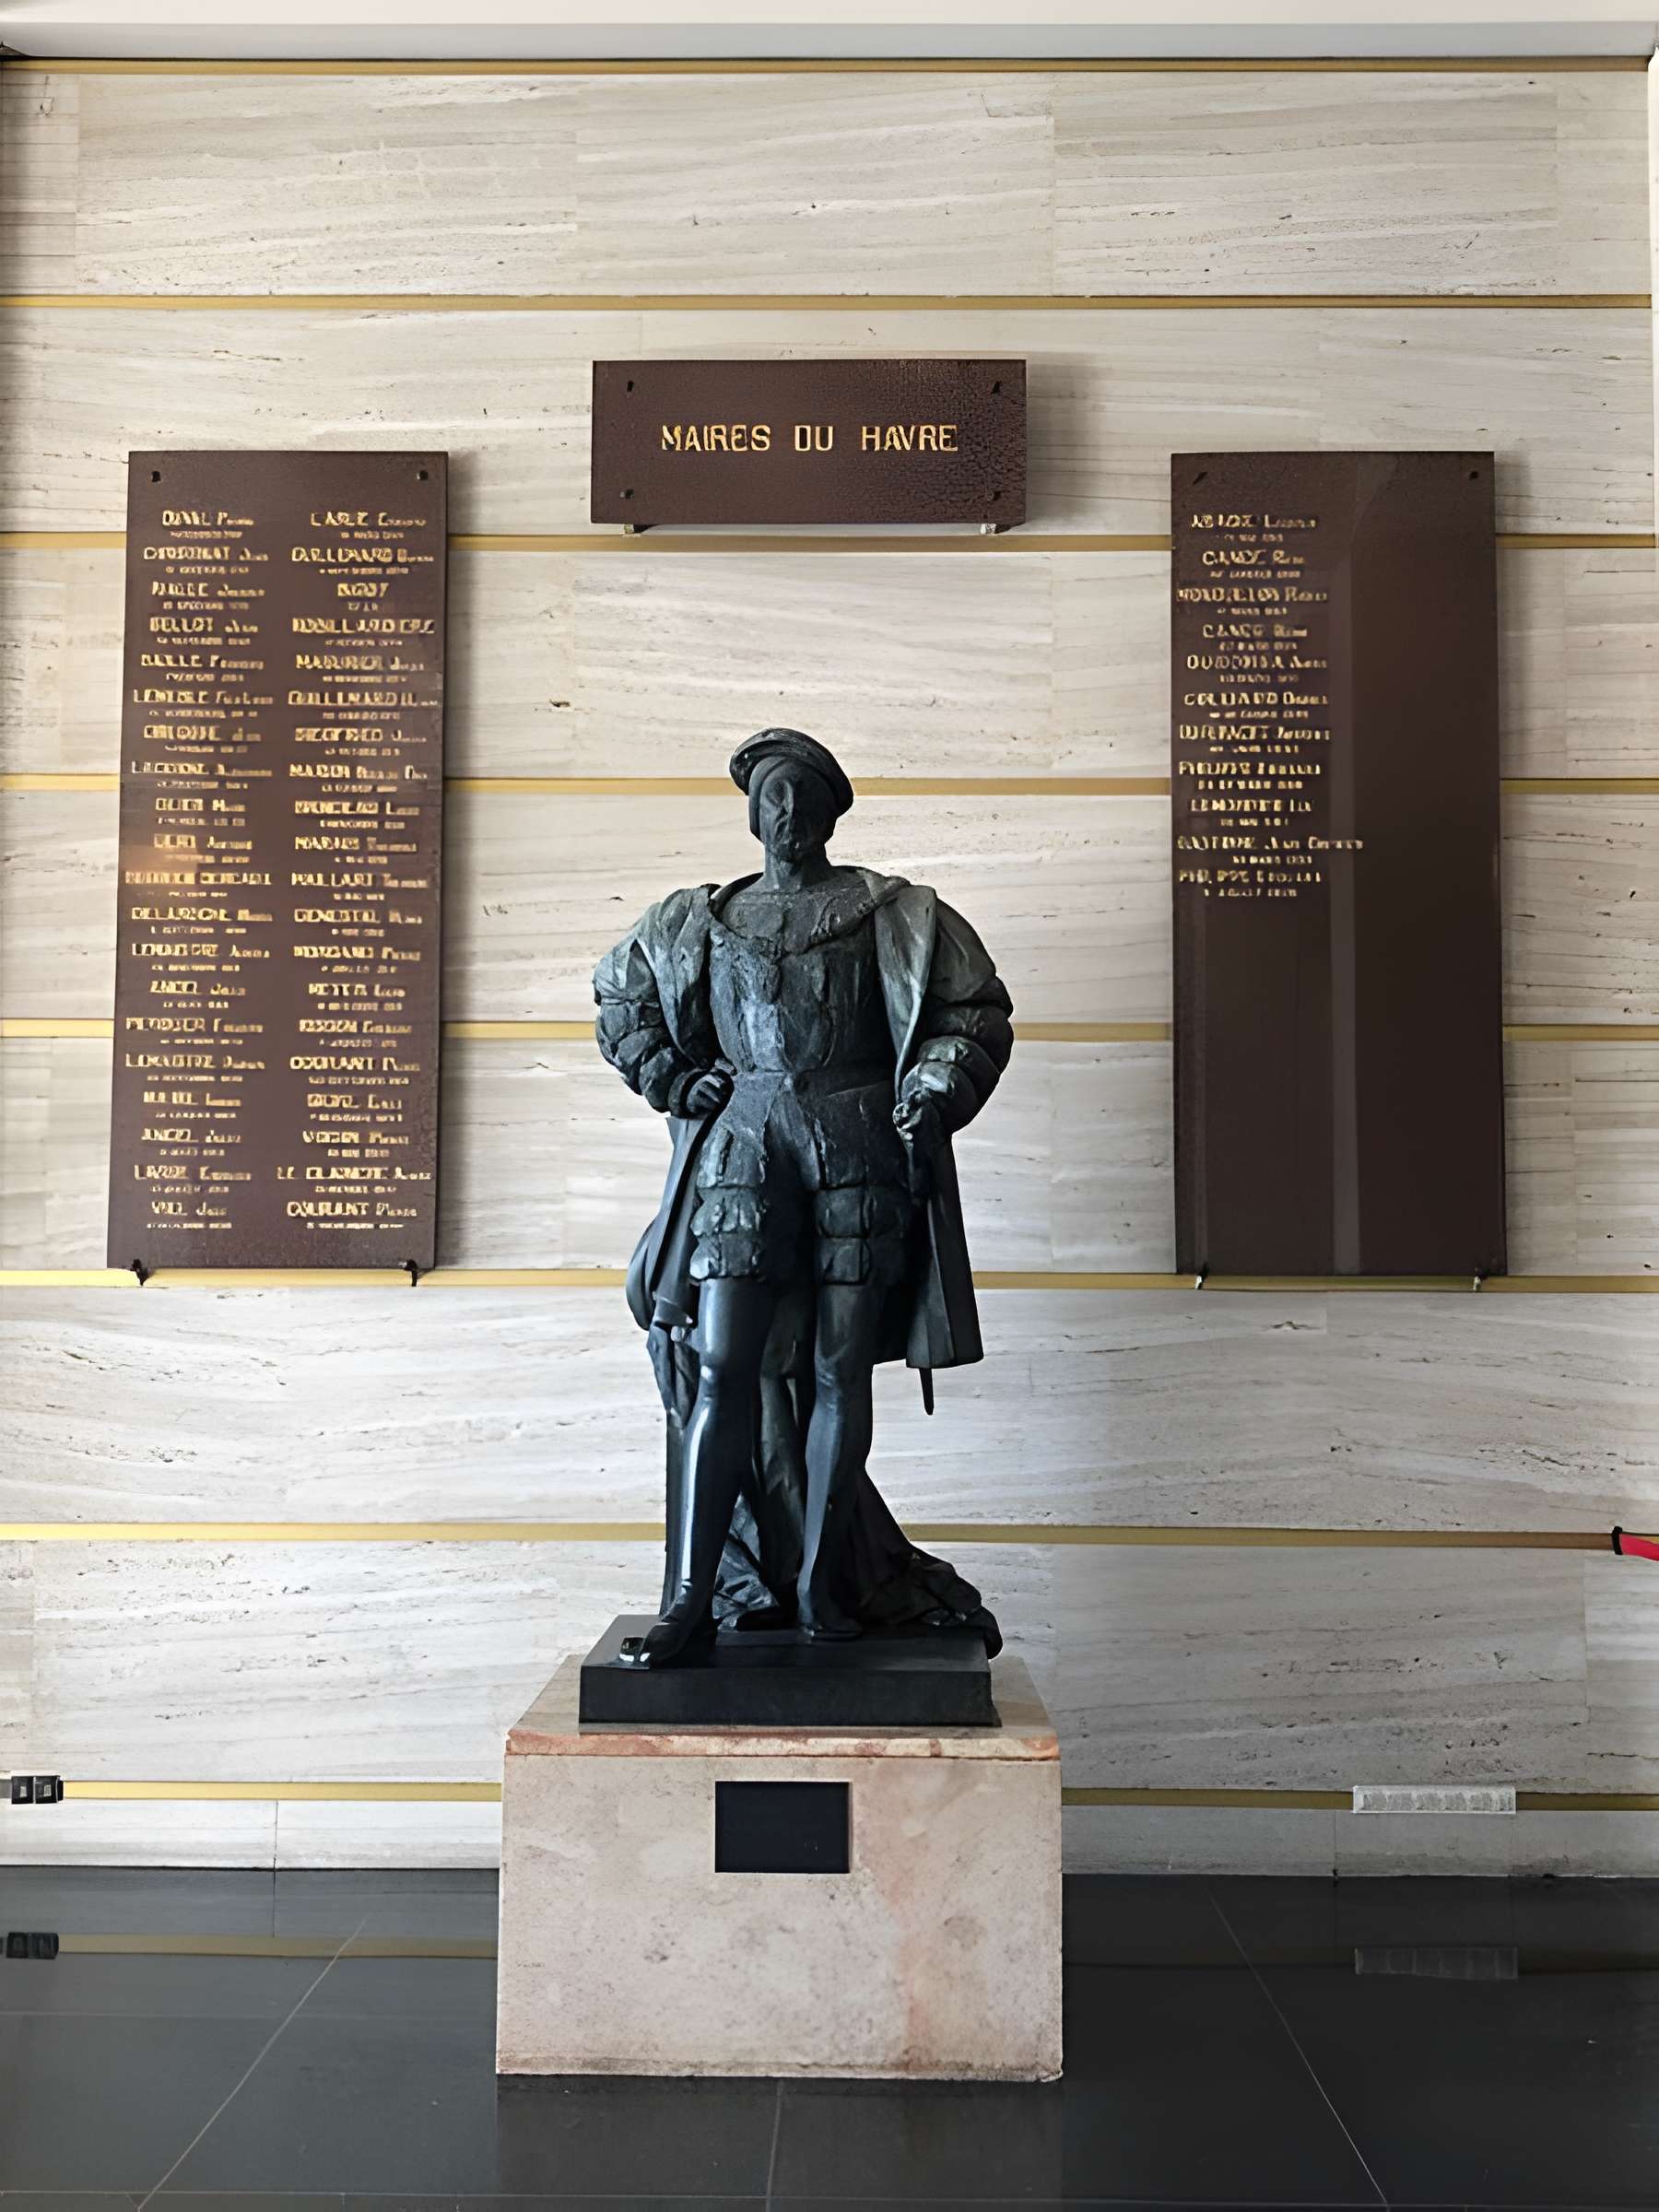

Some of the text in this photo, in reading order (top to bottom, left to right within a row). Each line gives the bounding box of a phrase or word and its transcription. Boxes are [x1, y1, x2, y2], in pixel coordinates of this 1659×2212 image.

[661, 424, 959, 453] MAIRES DU HAVRE
